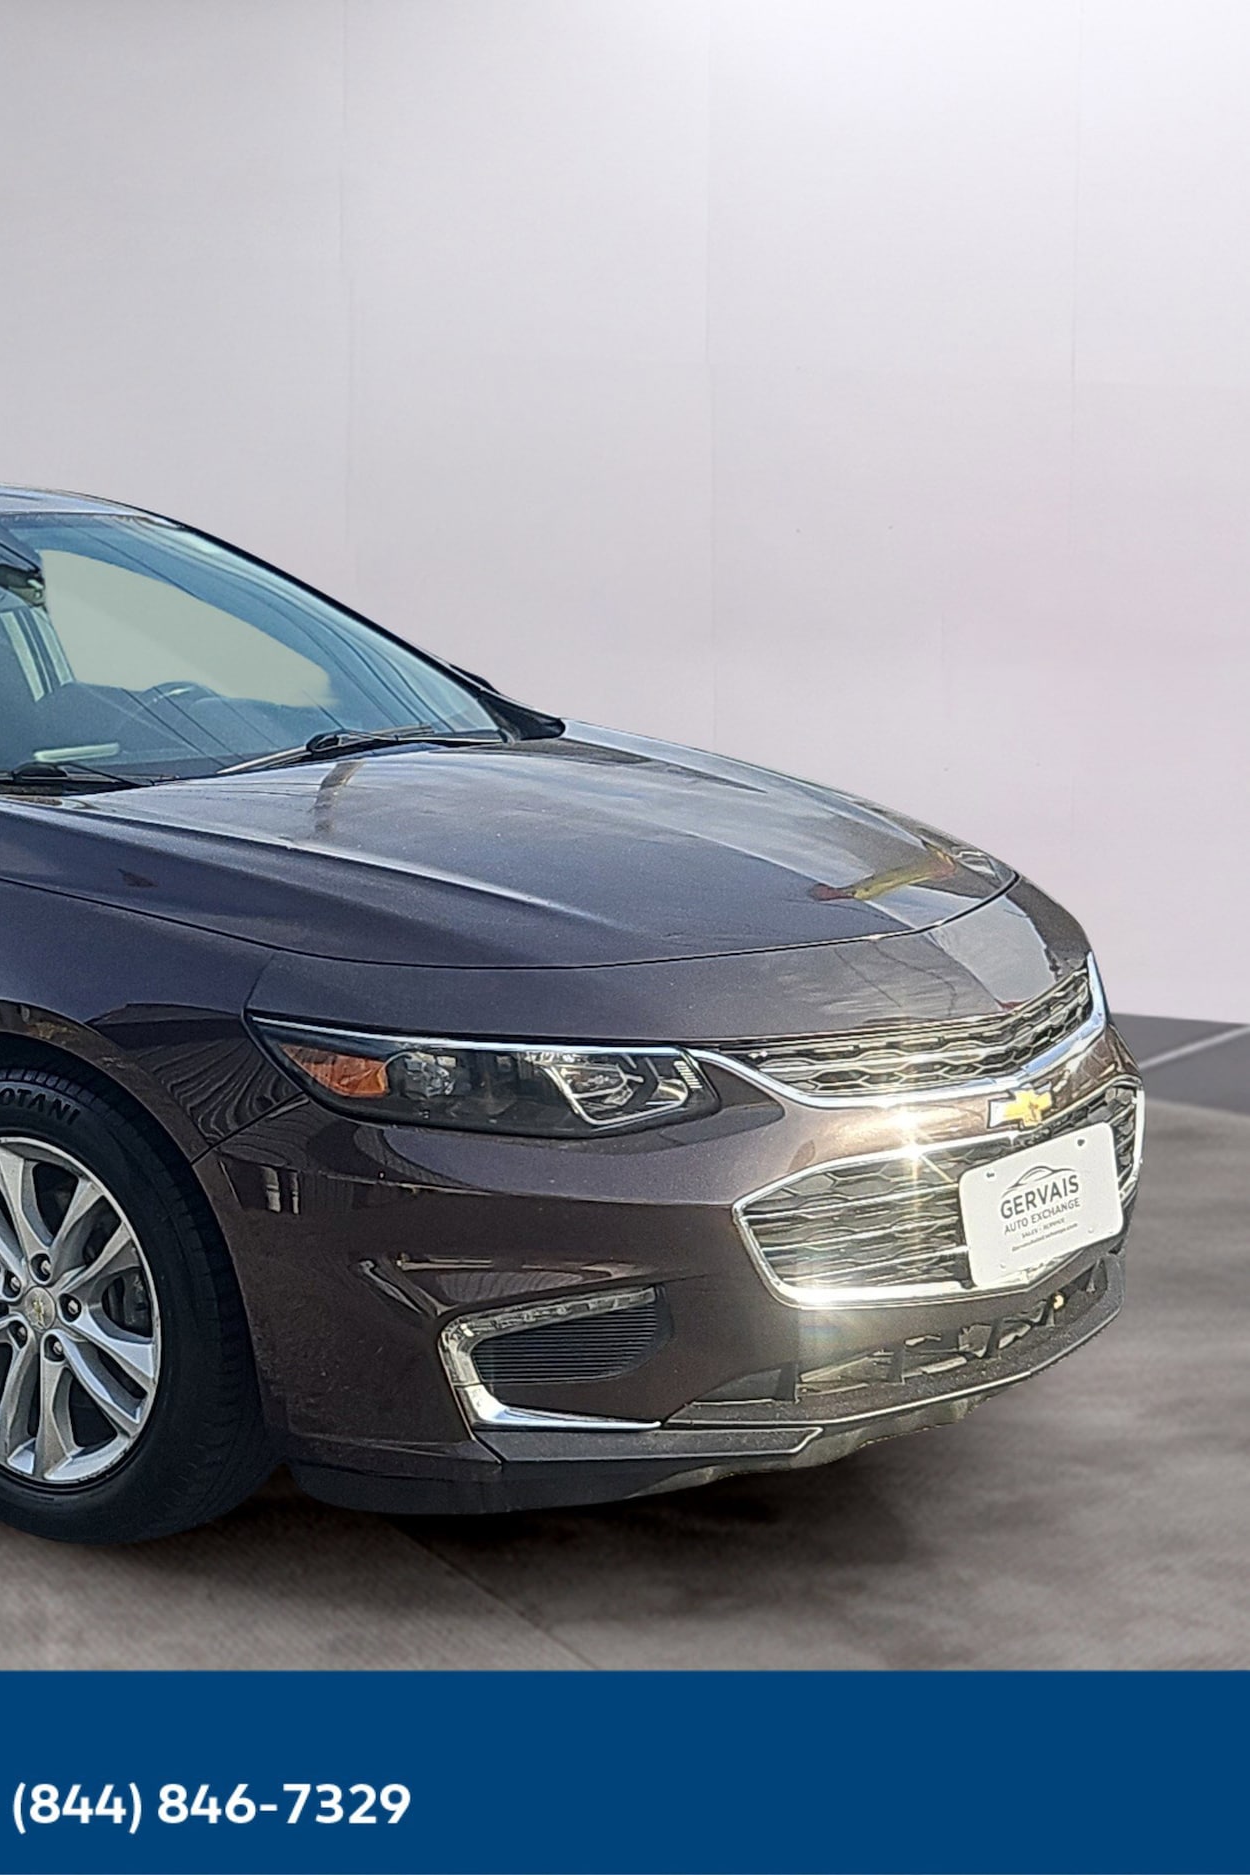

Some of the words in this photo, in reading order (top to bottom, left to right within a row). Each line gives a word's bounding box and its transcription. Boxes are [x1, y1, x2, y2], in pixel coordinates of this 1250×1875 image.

[1000, 1174, 1079, 1219] GERVAIS
[1004, 1217, 1028, 1235] AUTO
[1031, 1197, 1079, 1223] EXCHANGE
